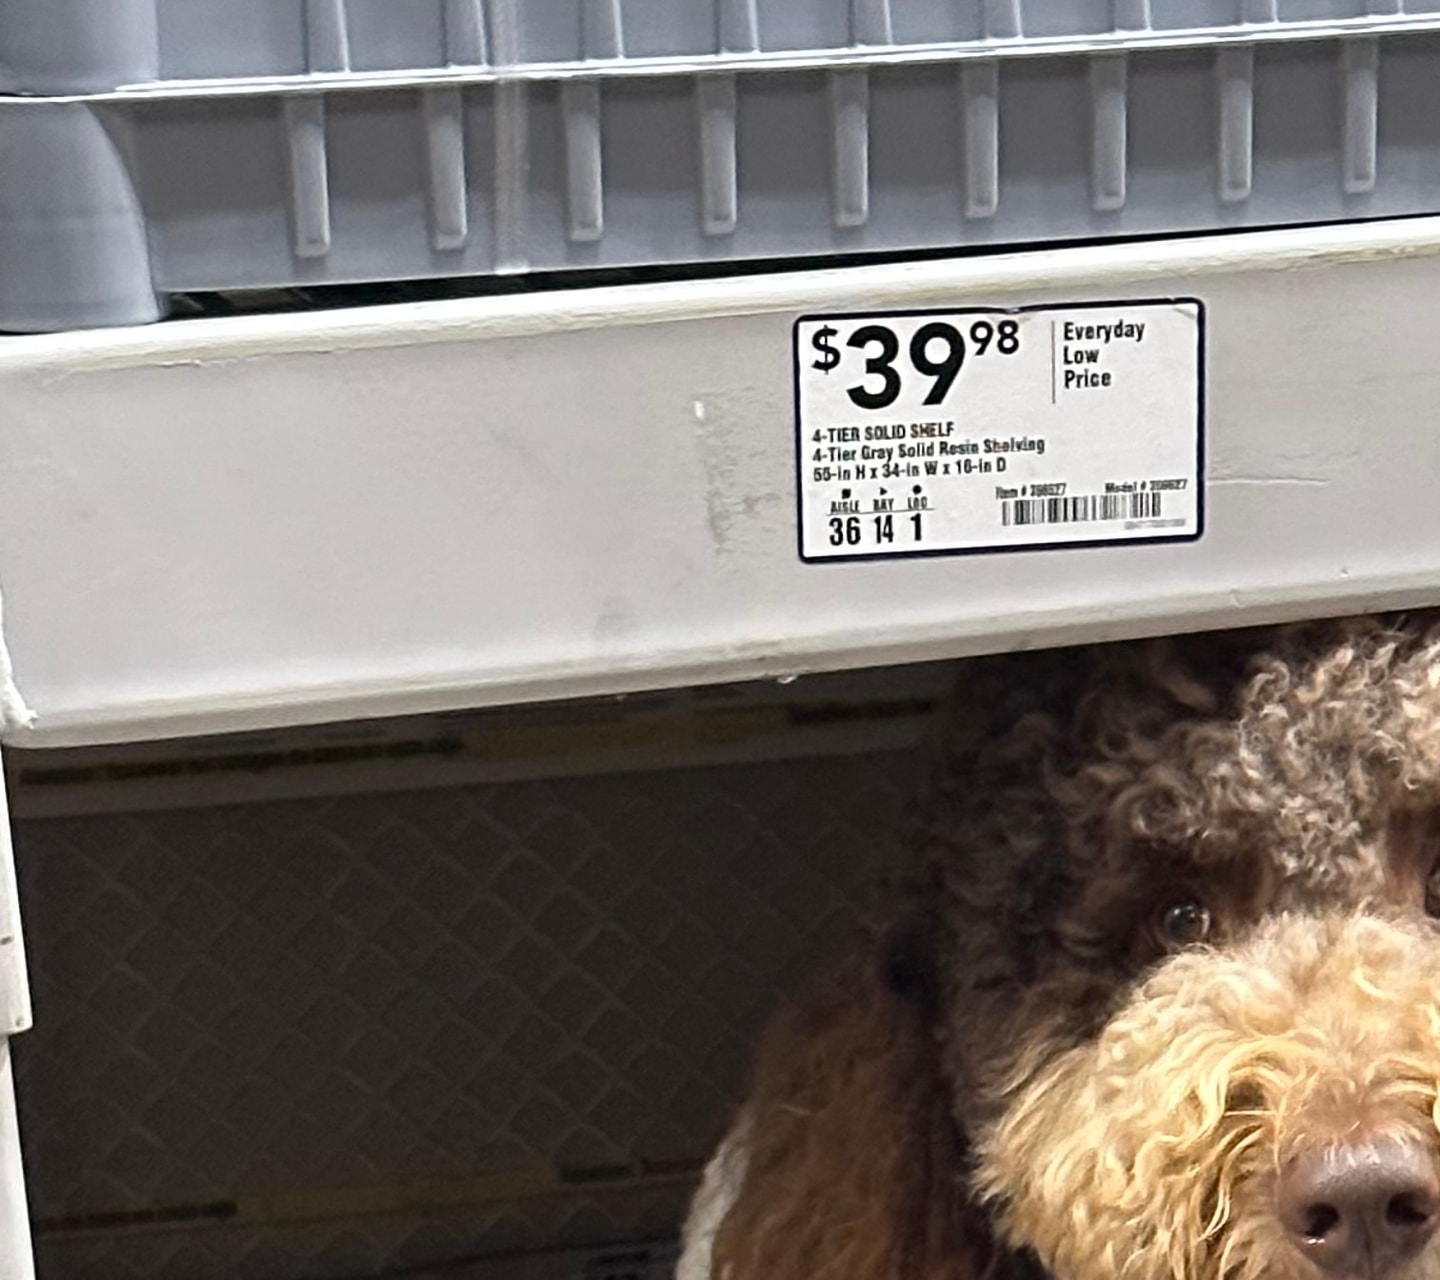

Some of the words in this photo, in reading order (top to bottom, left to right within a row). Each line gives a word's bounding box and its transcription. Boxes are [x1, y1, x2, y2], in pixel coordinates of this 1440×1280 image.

[1064, 319, 1145, 344] Everyday
[1063, 346, 1099, 364] Low
[1064, 369, 1112, 388] Price
[812, 427, 861, 443] 4-TIER
[864, 424, 906, 441] SOLID
[910, 420, 954, 438] SHELF
[812, 446, 856, 462] 4-Tier
[861, 444, 894, 464] Gray
[897, 441, 935, 459] Solid
[939, 439, 980, 456] Resin
[983, 436, 1046, 456] Shelving
[855, 464, 866, 480] H
[870, 467, 879, 479] x
[882, 462, 920, 479] 34-in
[924, 460, 938, 476] W
[942, 463, 951, 475] x
[996, 456, 1007, 472] D
[830, 499, 862, 514] AISLE
[829, 516, 861, 547] 36
[873, 513, 894, 544] 14
[910, 512, 923, 541] 1
